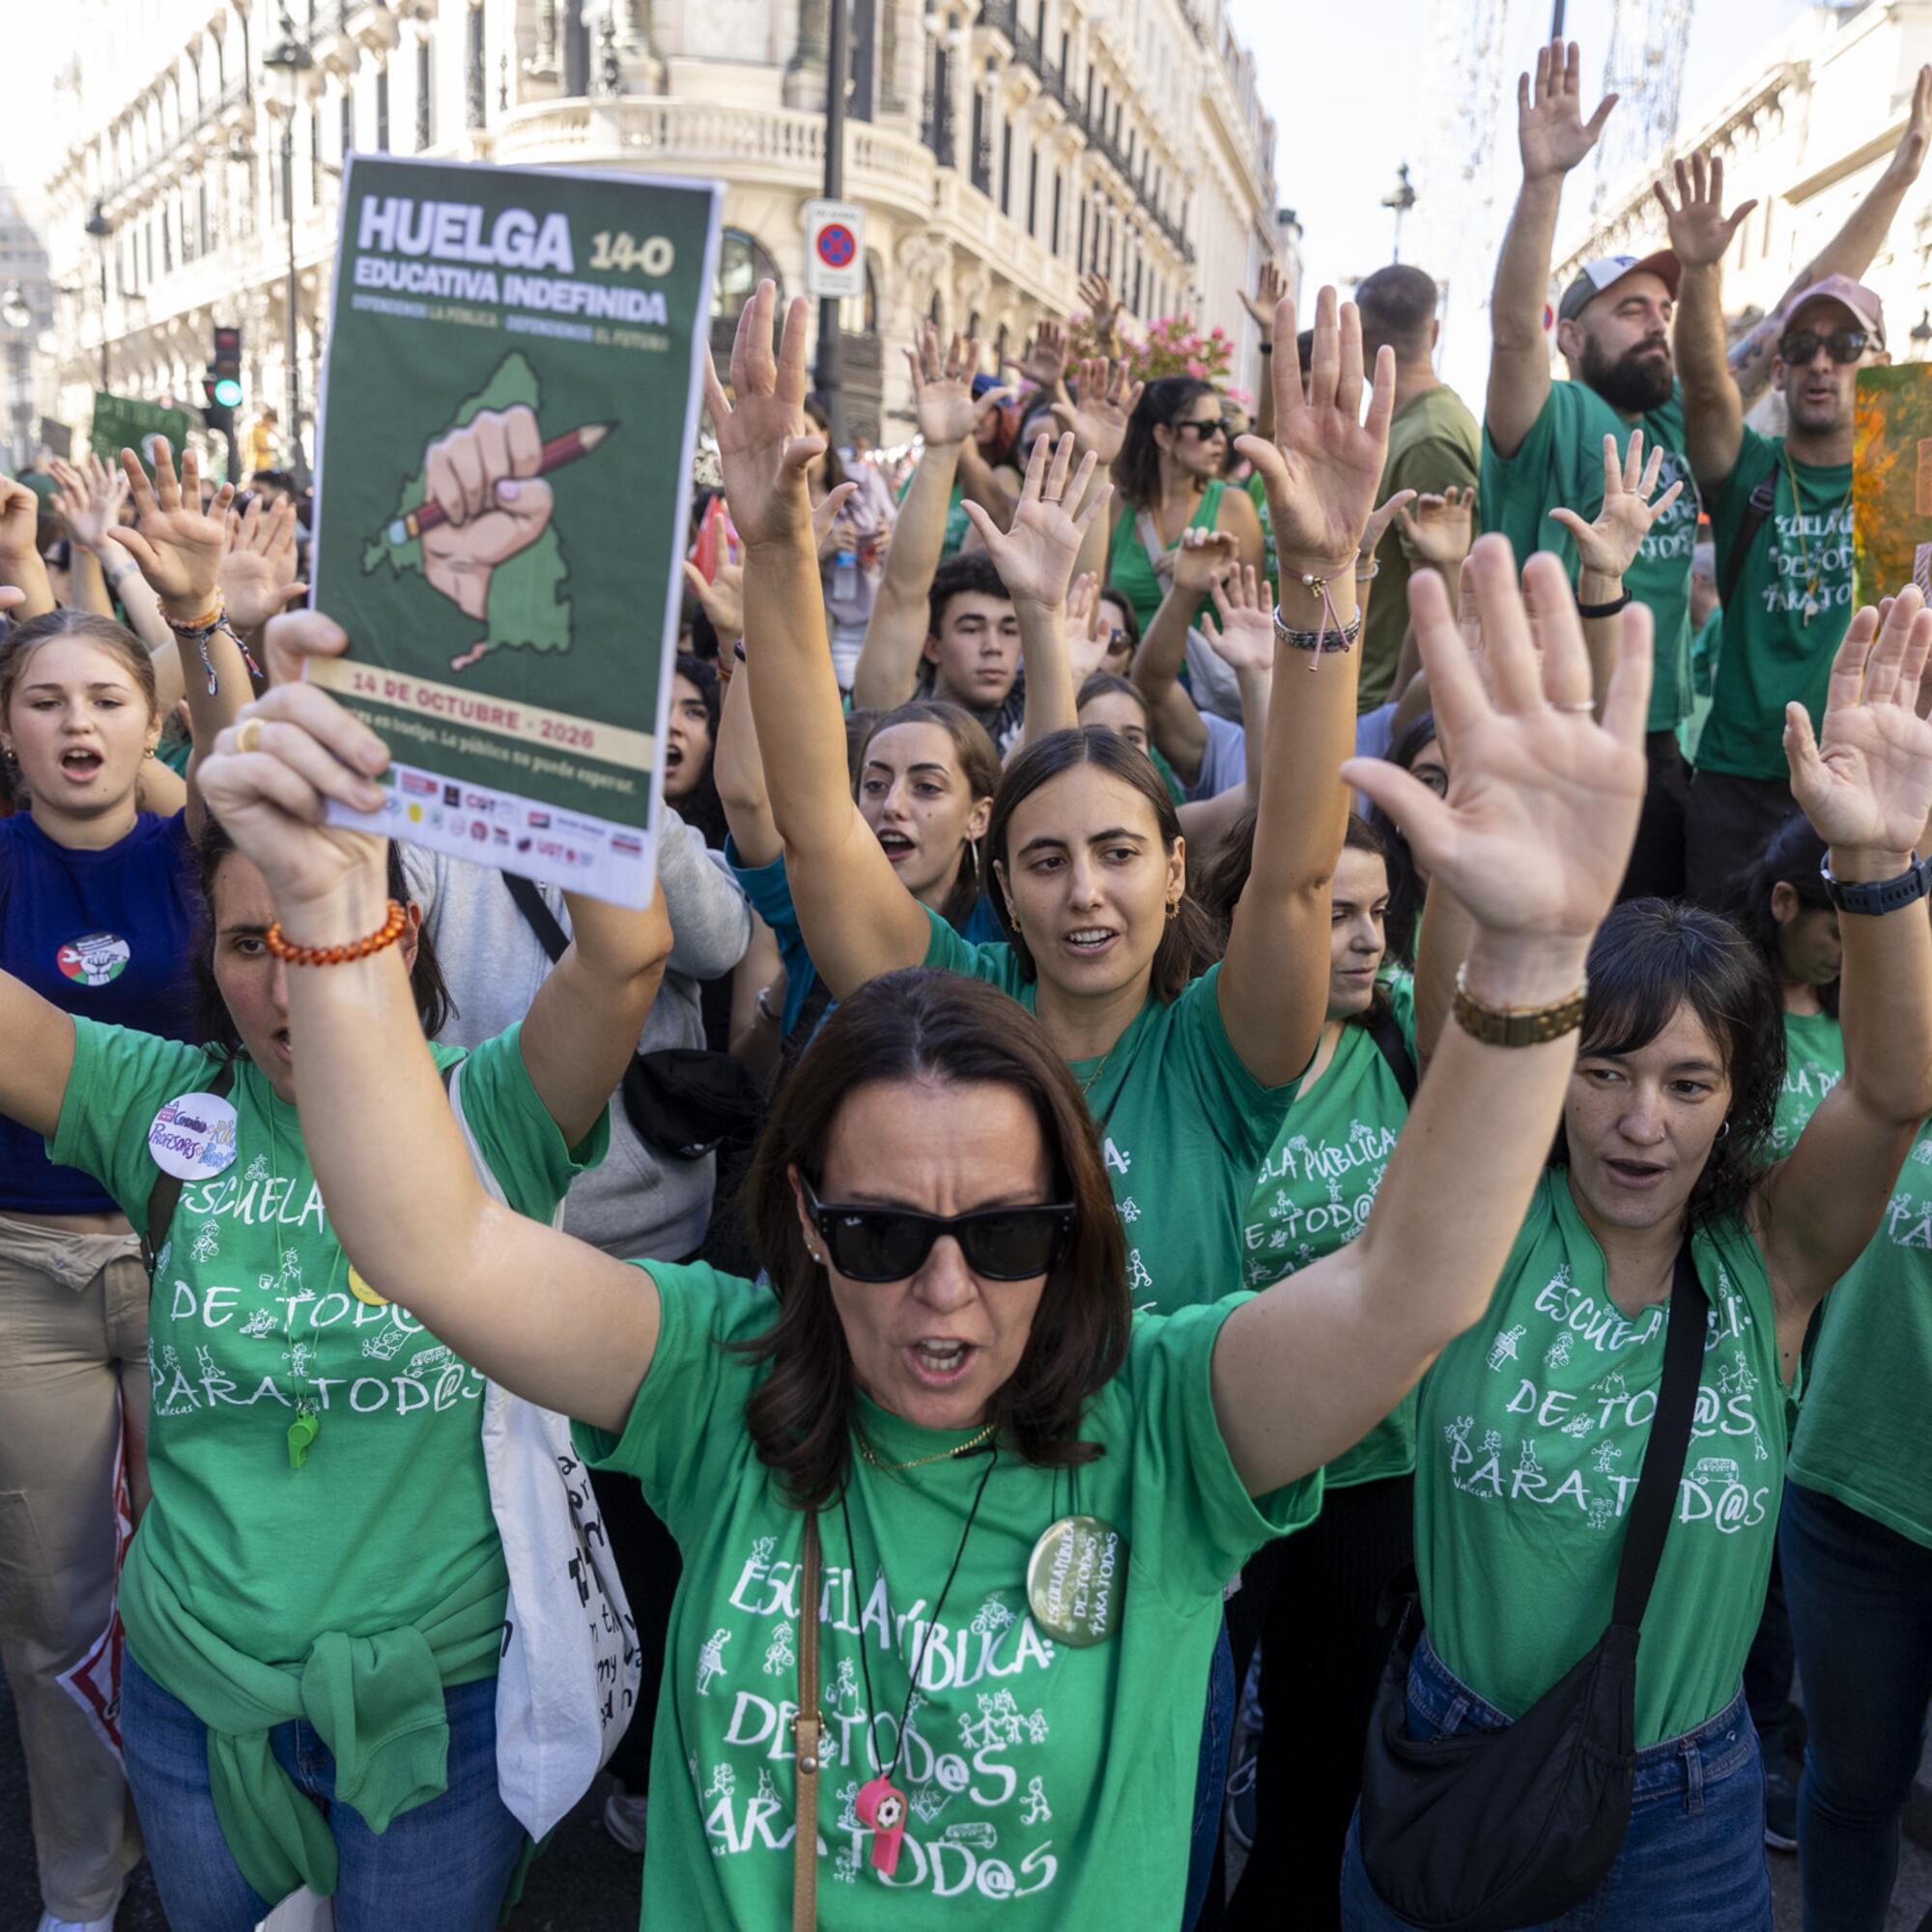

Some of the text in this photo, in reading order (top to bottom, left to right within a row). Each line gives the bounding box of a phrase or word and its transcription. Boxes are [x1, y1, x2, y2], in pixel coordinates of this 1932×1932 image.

[358, 195, 575, 273] HUELGA
[354, 256, 668, 326] EDUCATIVA INDEFINIDA
[354, 672, 377, 693] 14
[384, 679, 410, 701] DE
[416, 687, 520, 731] OCTUBRE
[541, 719, 595, 749] 2026
[171, 1280, 241, 1327] DE
[1506, 1379, 1577, 1428] DE
[1451, 1435, 1770, 1534] PARA TD@S
[724, 1690, 1017, 1805] DE TOD@S
[837, 1823, 1059, 1900] TOD@S
